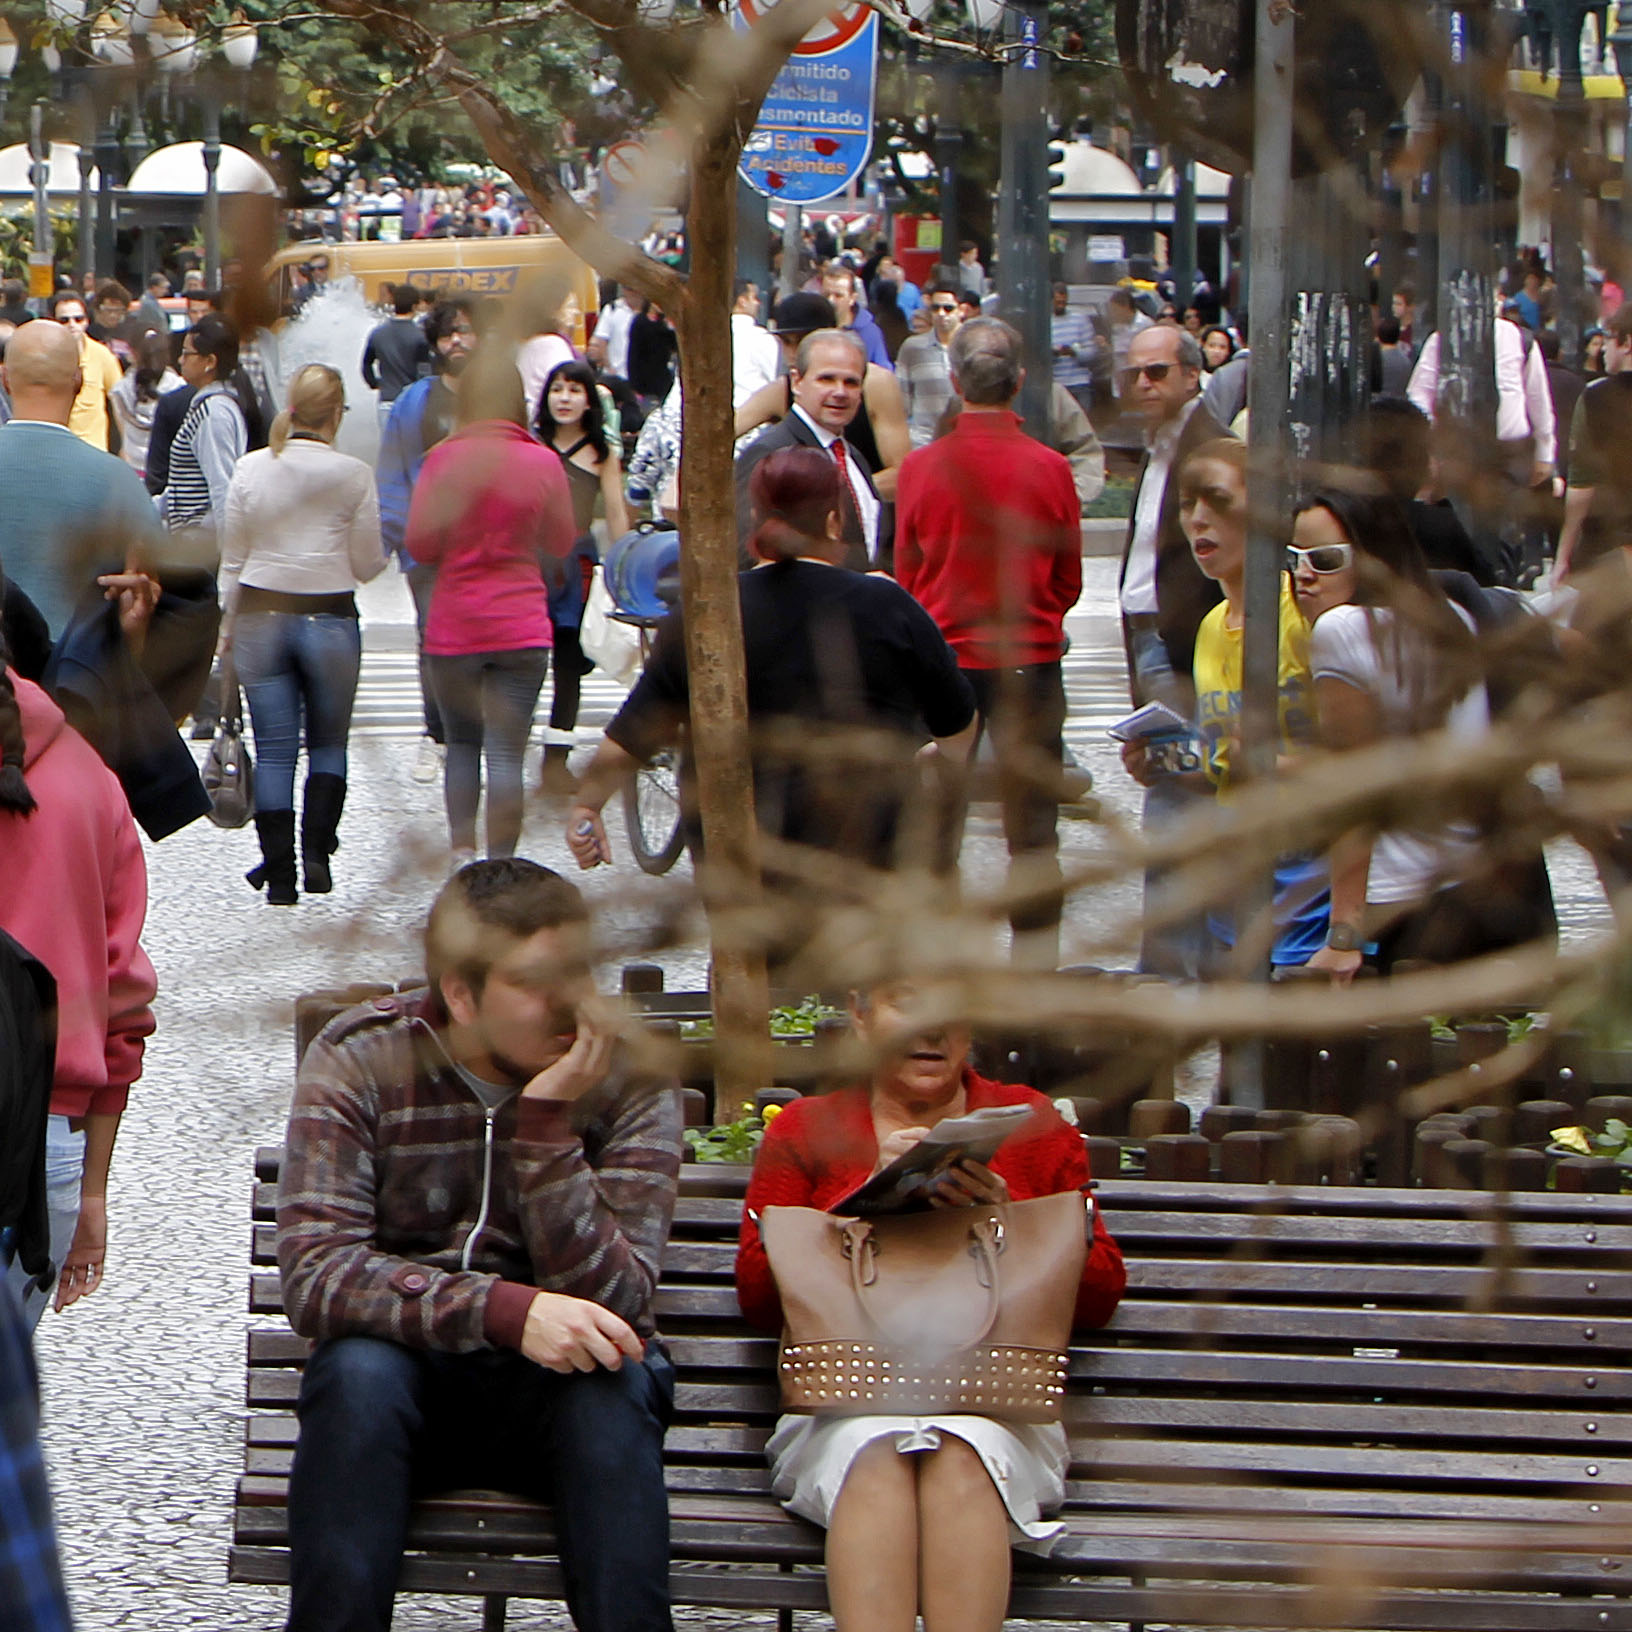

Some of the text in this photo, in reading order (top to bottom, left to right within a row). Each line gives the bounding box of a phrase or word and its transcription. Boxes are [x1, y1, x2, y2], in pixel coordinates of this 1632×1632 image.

[779, 63, 851, 80] rmitido
[758, 108, 864, 126] smontado
[775, 134, 816, 152] Evit
